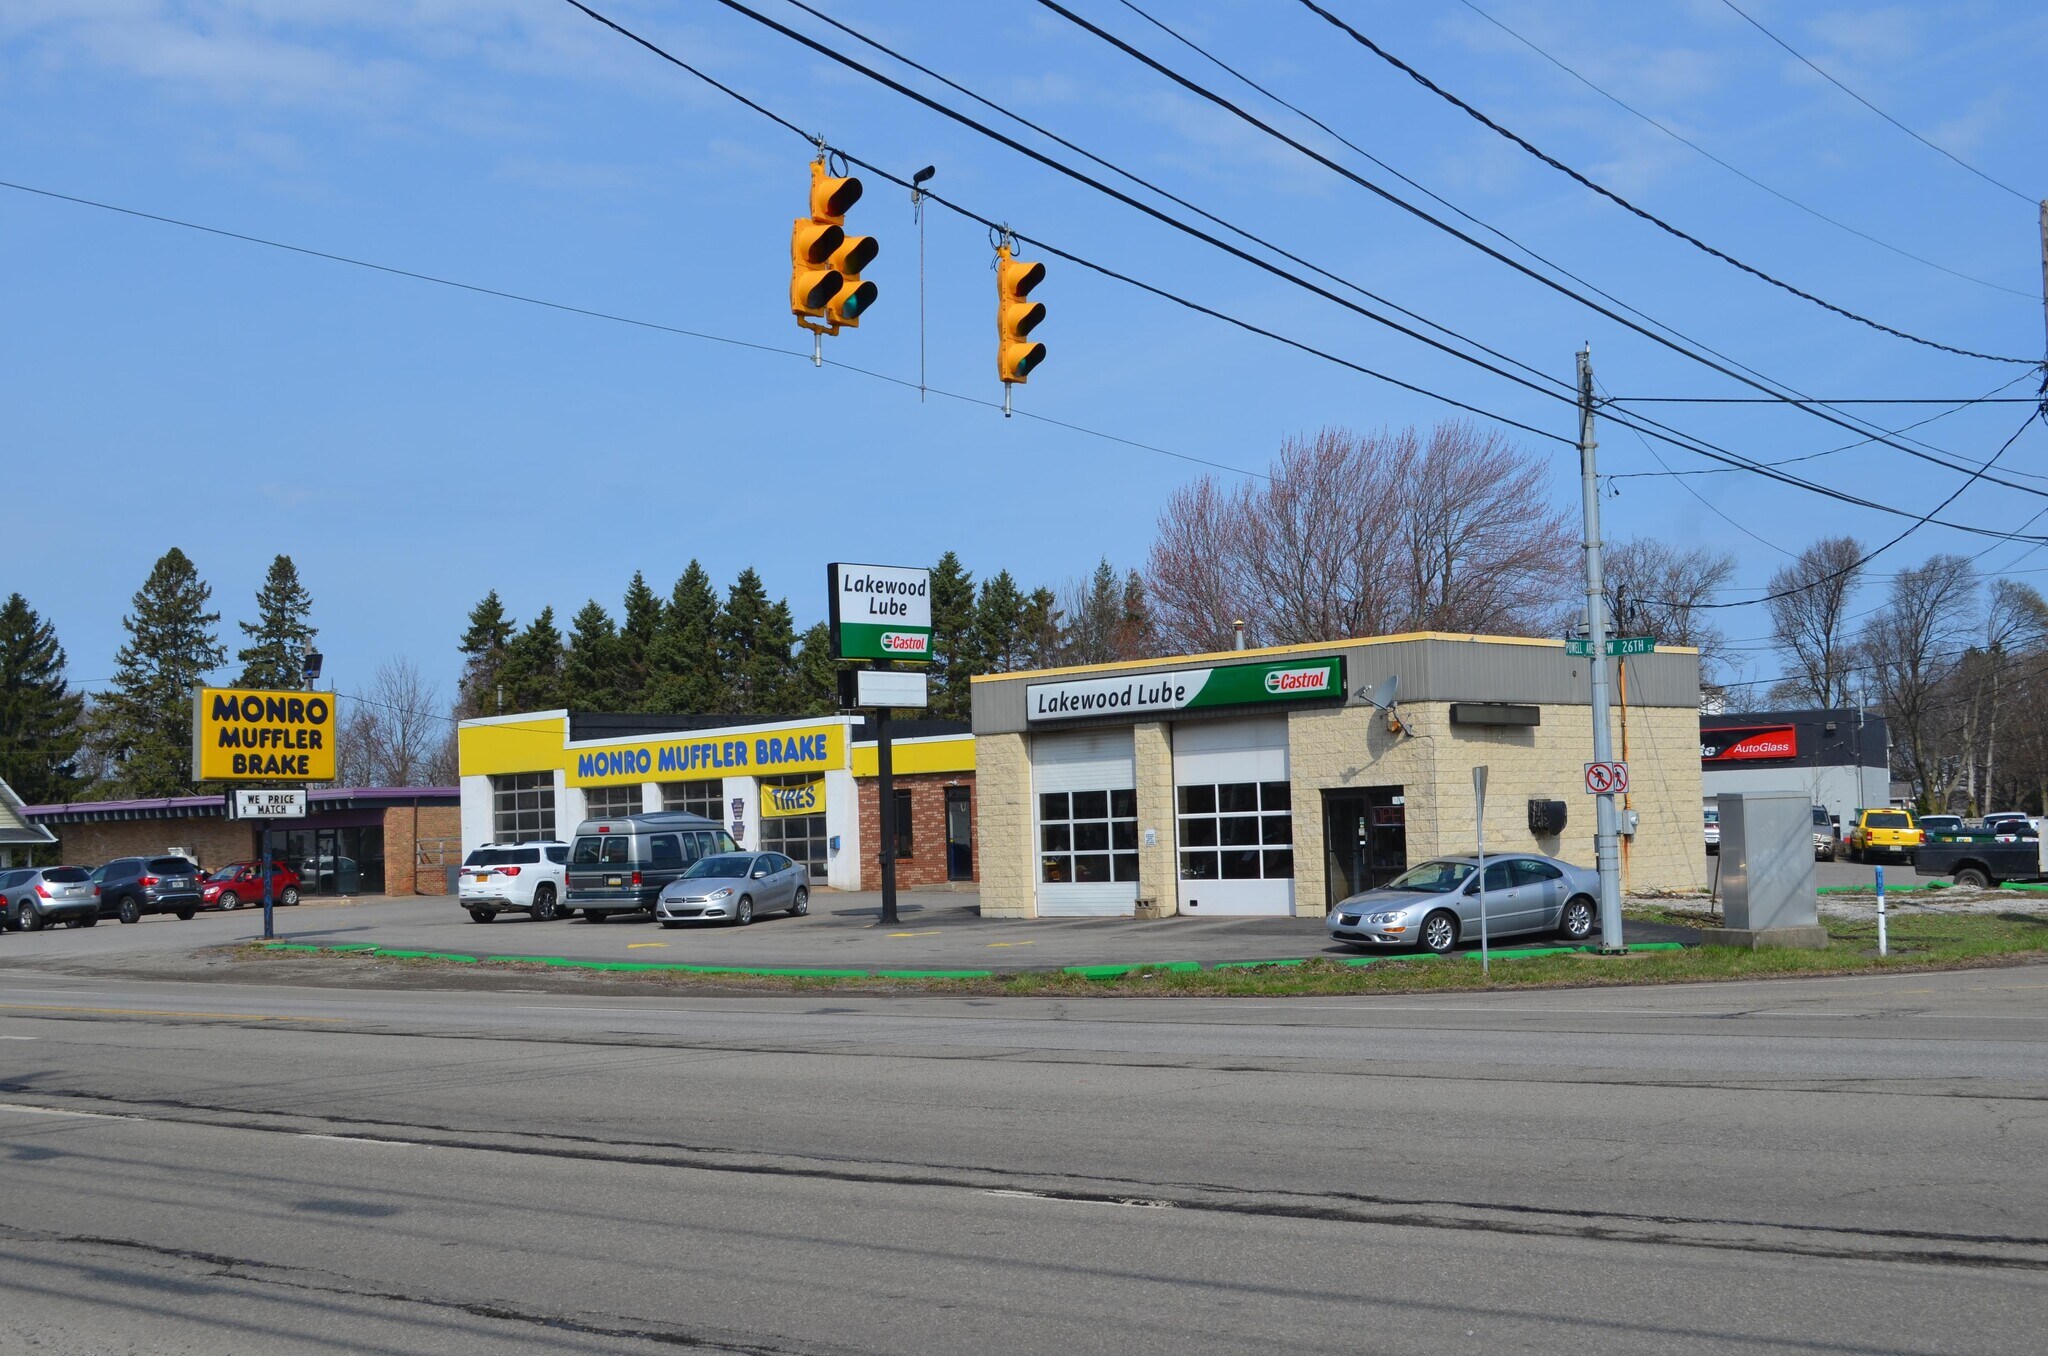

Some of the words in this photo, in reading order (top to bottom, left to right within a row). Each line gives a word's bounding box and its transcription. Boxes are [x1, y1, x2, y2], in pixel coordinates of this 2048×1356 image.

[844, 574, 926, 597] Lakewood
[869, 597, 907, 616] Lube
[893, 635, 925, 650] Castrol
[1566, 641, 1583, 654] POWELL
[1606, 642, 1614, 654] W
[1622, 639, 1644, 653] 26TH
[1280, 671, 1325, 690] Castrol
[1038, 684, 1132, 714] Lakewood
[1138, 681, 1186, 705] Lube
[212, 695, 328, 725] MONRO
[218, 727, 323, 749] MUFFLER
[1734, 742, 1789, 753] AutoGlass
[233, 753, 310, 775] BRAKE
[578, 749, 651, 777] MONRO
[658, 741, 748, 772] MUFFLER
[755, 734, 828, 765] BRAKE
[248, 795, 260, 804] WE
[268, 795, 295, 803] PRICE
[771, 785, 816, 811] TIRES
[242, 806, 247, 814] $
[257, 805, 287, 814] MATCH
[299, 806, 303, 814] $
